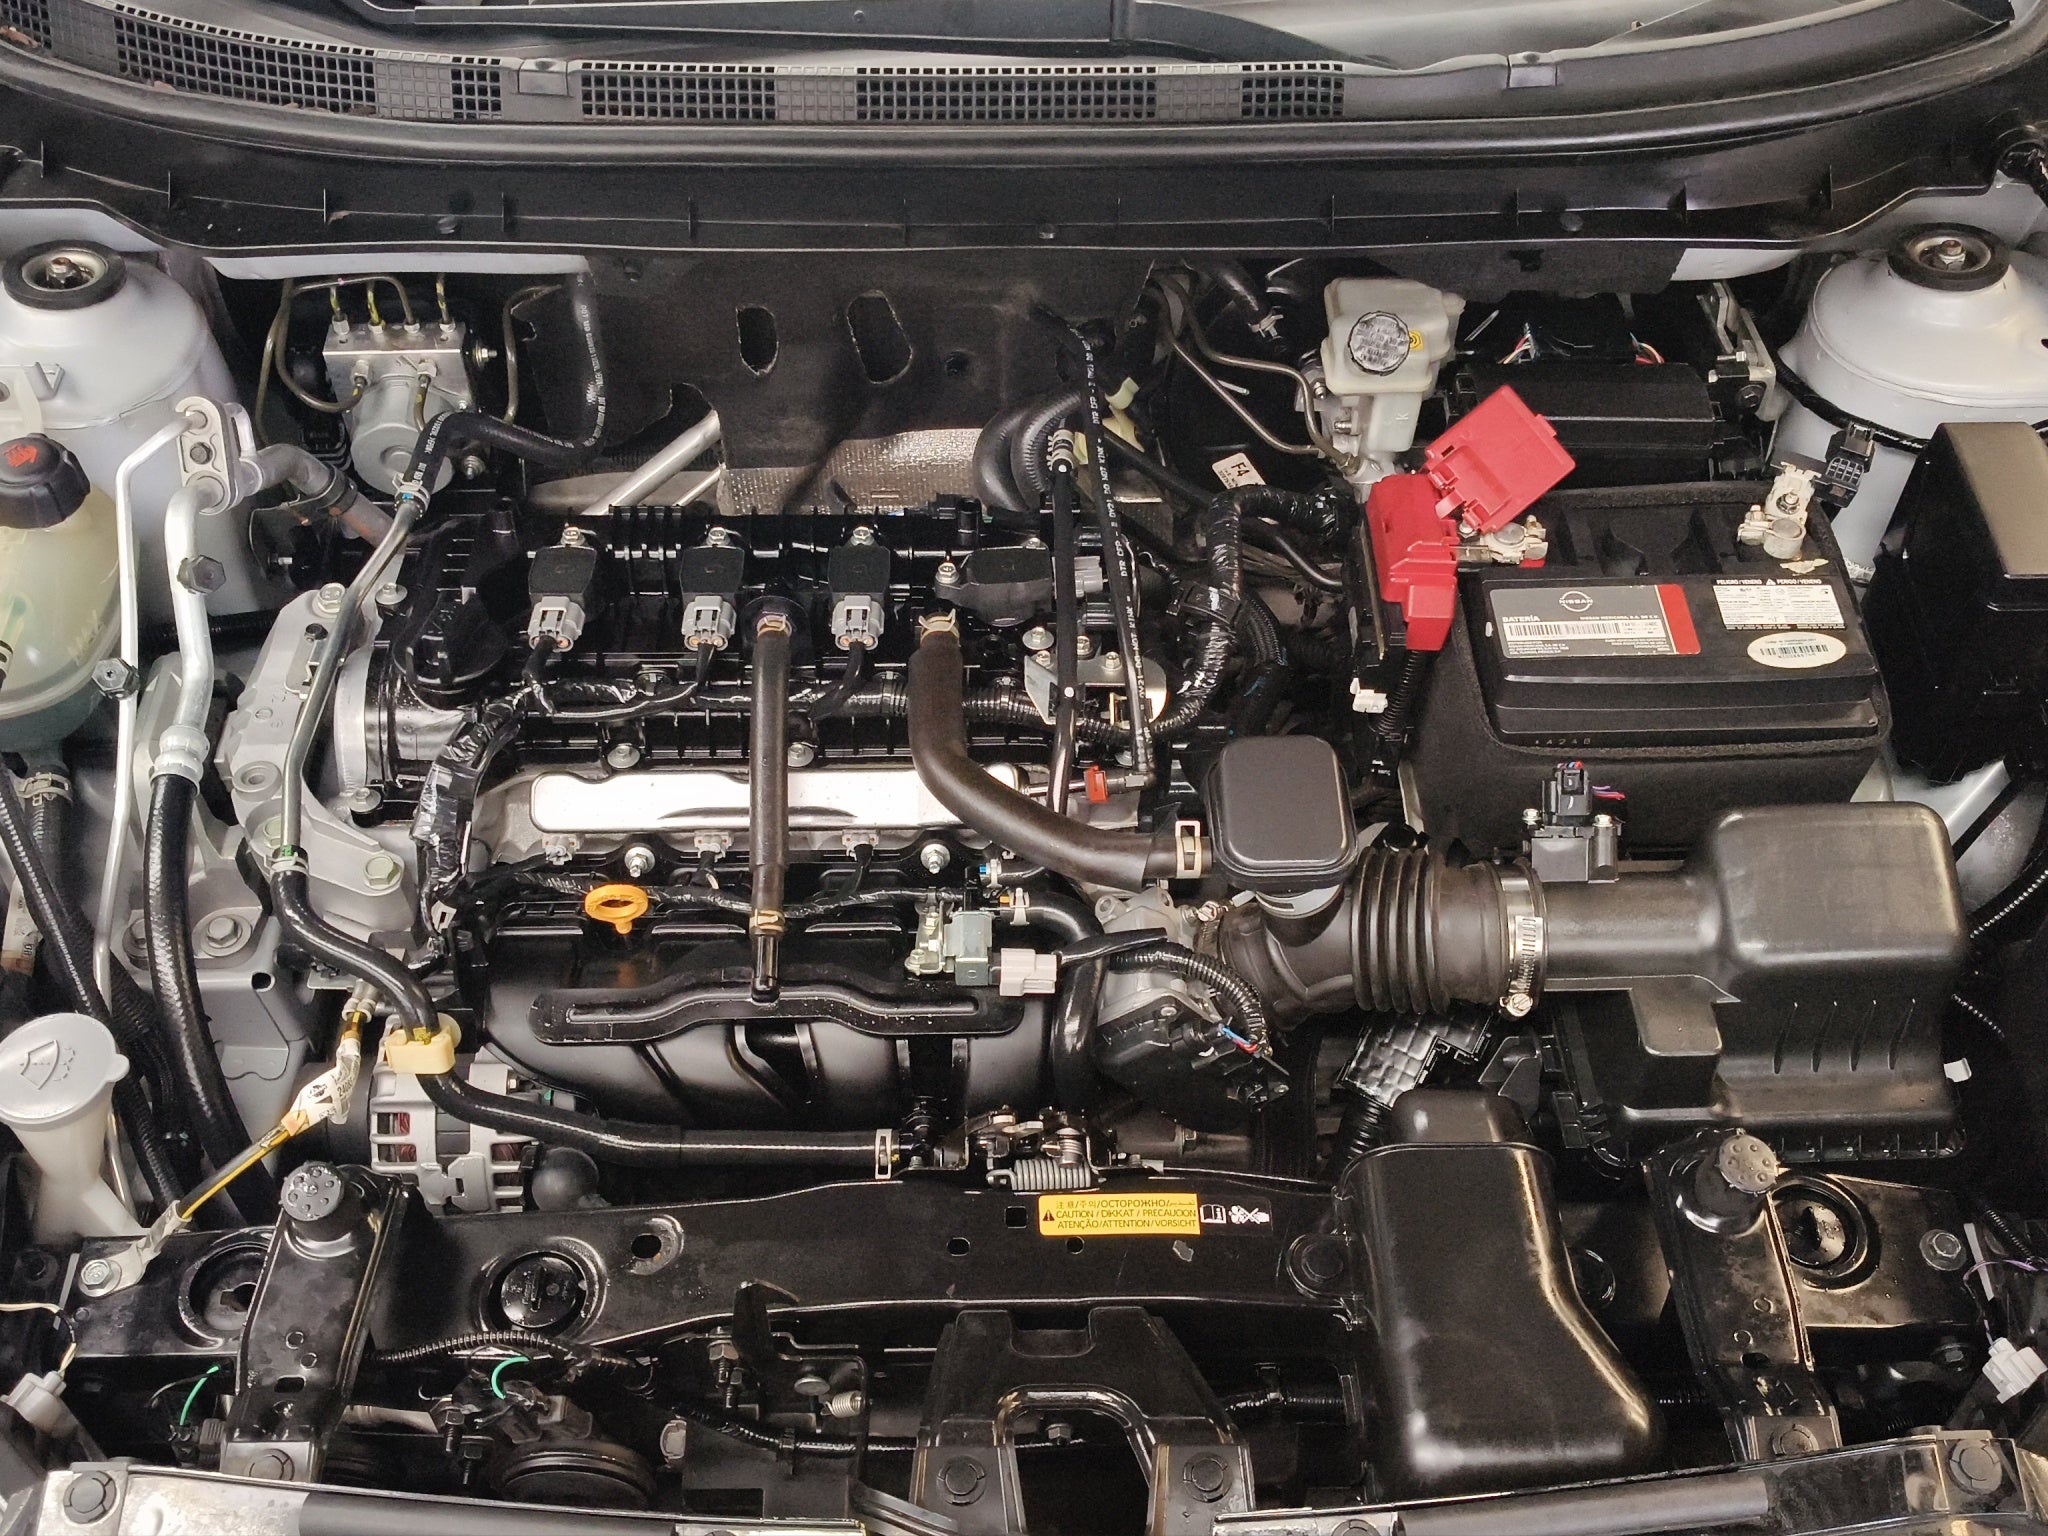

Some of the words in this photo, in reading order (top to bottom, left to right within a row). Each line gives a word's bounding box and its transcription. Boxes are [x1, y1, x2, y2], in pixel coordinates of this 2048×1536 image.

[1231, 461, 1250, 477] F4
[1502, 614, 1541, 623] BATERÍA
[1056, 1210, 1094, 1218] CAUTION
